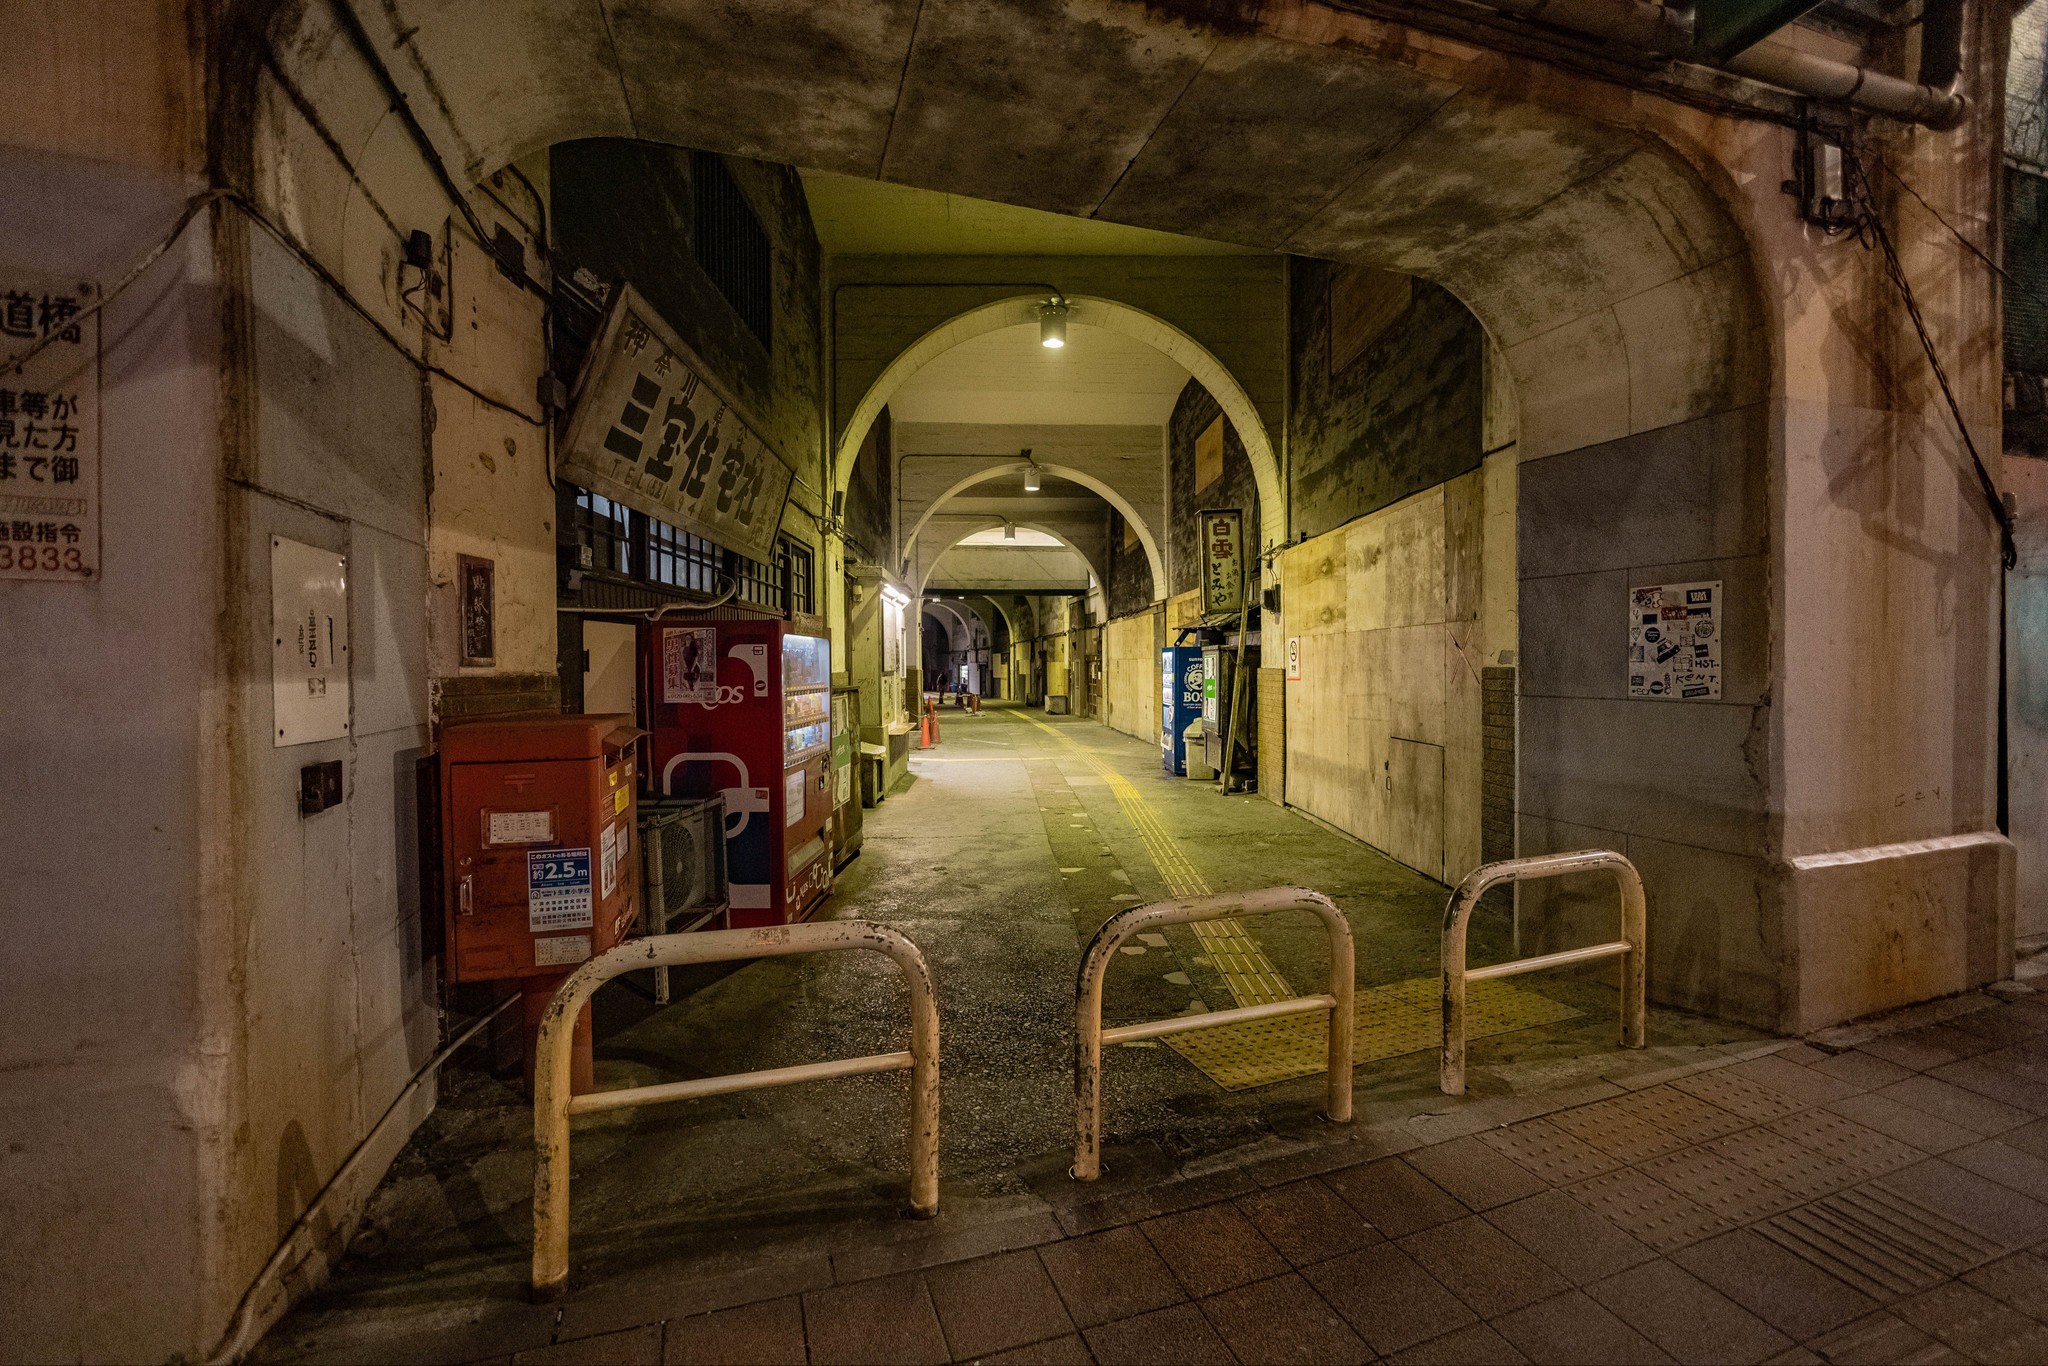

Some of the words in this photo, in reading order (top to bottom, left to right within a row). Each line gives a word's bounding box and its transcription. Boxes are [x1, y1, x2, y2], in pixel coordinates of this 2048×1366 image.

[1211, 518, 1234, 560] 白雪
[1210, 563, 1227, 607] とみや
[666, 638, 680, 689] 男性募集
